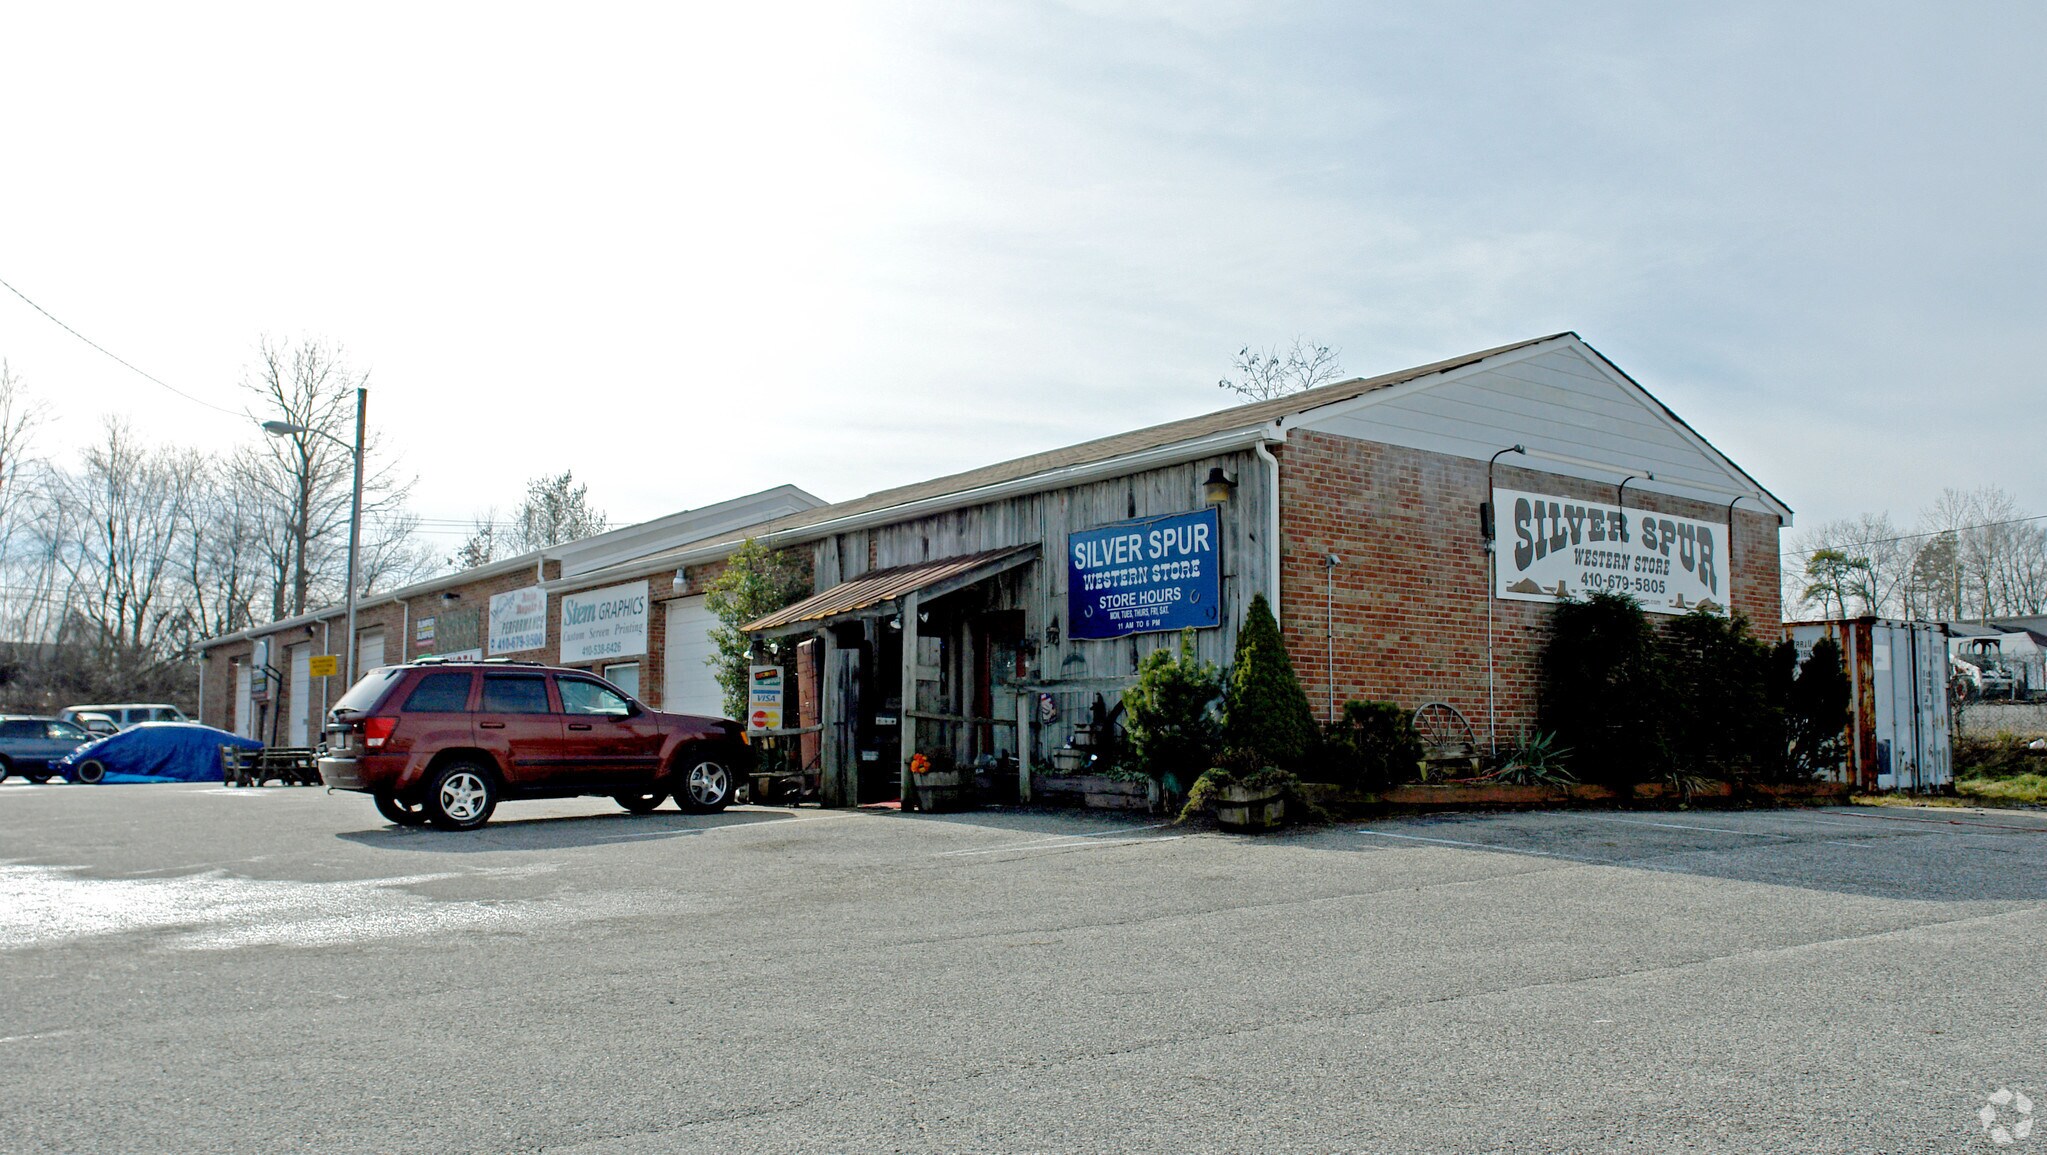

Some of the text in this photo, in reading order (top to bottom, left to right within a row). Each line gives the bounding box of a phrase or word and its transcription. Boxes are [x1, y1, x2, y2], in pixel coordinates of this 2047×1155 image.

[1074, 523, 1210, 570] SILVER SPUR
[1514, 498, 1717, 597] SILVER SPUR
[1083, 559, 1201, 591] WESTERN STORE
[1574, 547, 1670, 576] WESTERN STORE
[1581, 571, 1666, 594] 410-679-5805
[563, 596, 644, 626] Stem GRAPHICS
[1100, 587, 1182, 609] STORE HOURS
[588, 627, 610, 639] Screen
[614, 621, 643, 636] Printing
[1118, 622, 1123, 630] 11
[1125, 621, 1134, 629] AM
[1136, 620, 1144, 628] TO
[1151, 619, 1161, 627] PM
